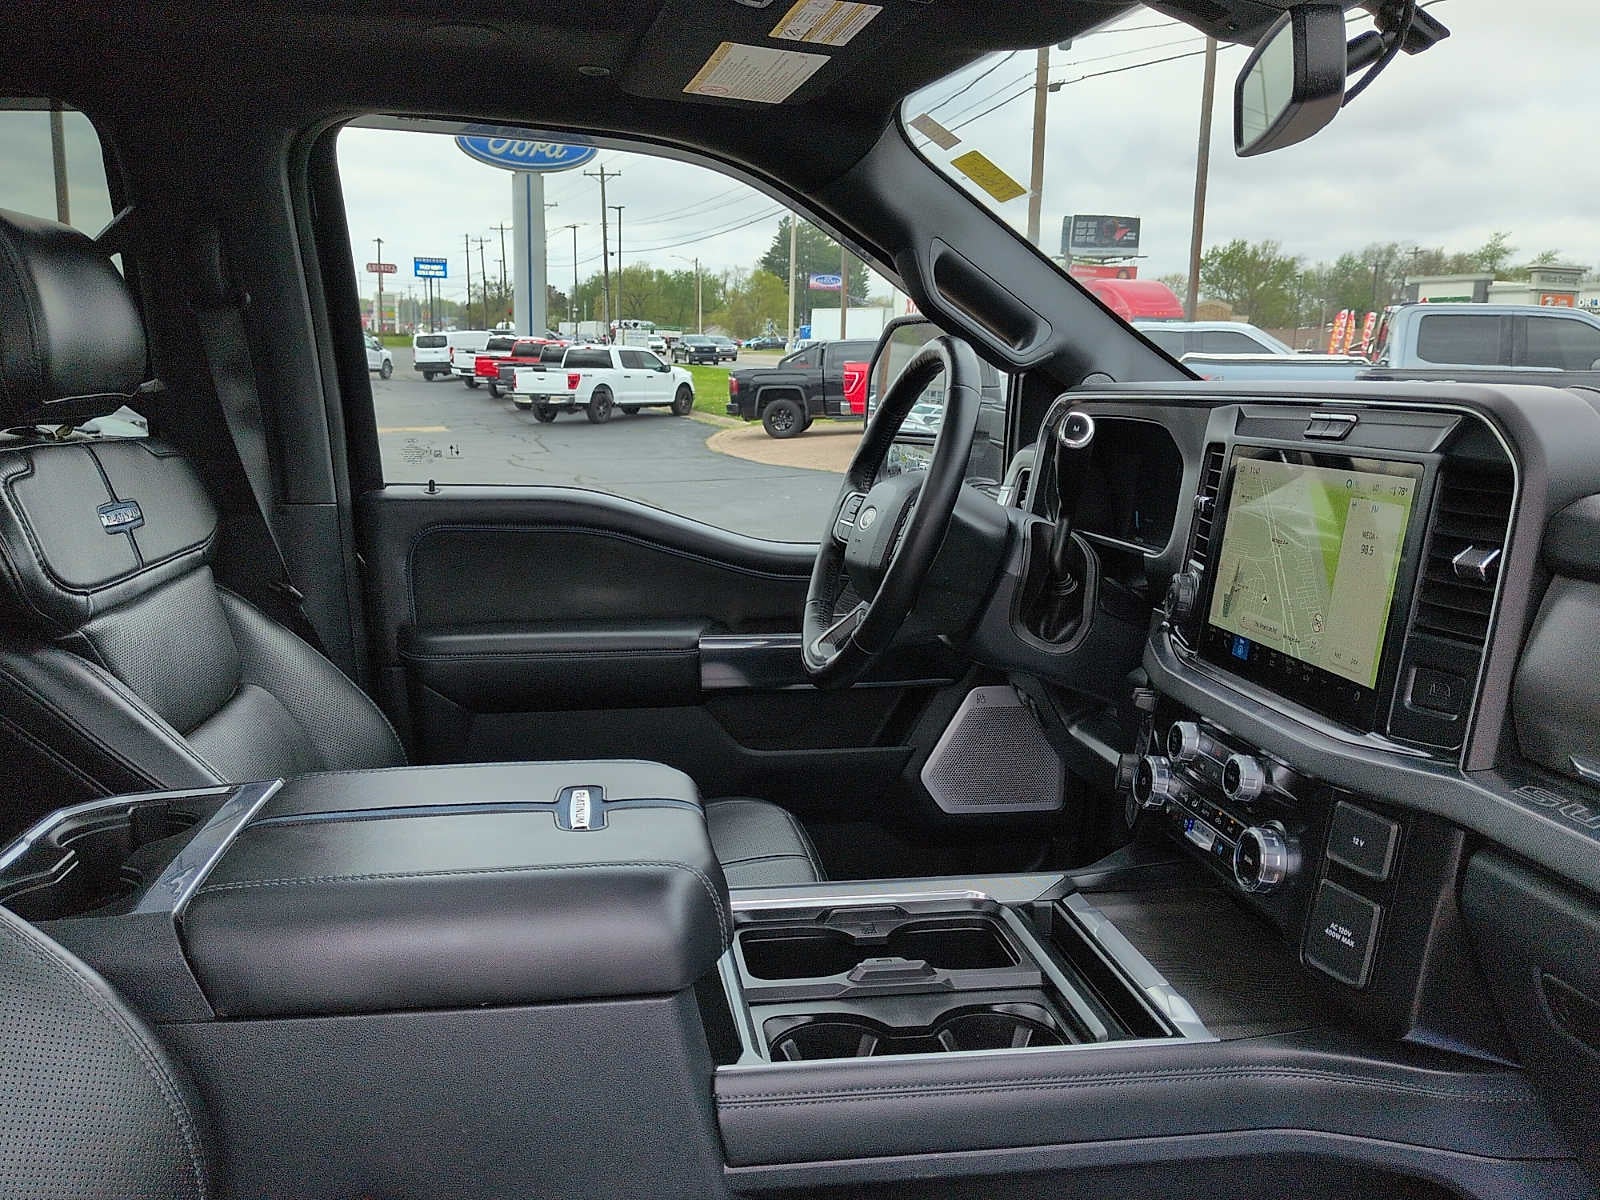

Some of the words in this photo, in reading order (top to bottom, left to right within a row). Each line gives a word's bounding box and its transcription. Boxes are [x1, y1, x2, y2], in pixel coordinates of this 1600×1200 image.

[575, 791, 586, 824] PLATINUM
[1330, 922, 1339, 932] AC
[1338, 926, 1352, 938] 120V
[1341, 935, 1355, 948] MAX
